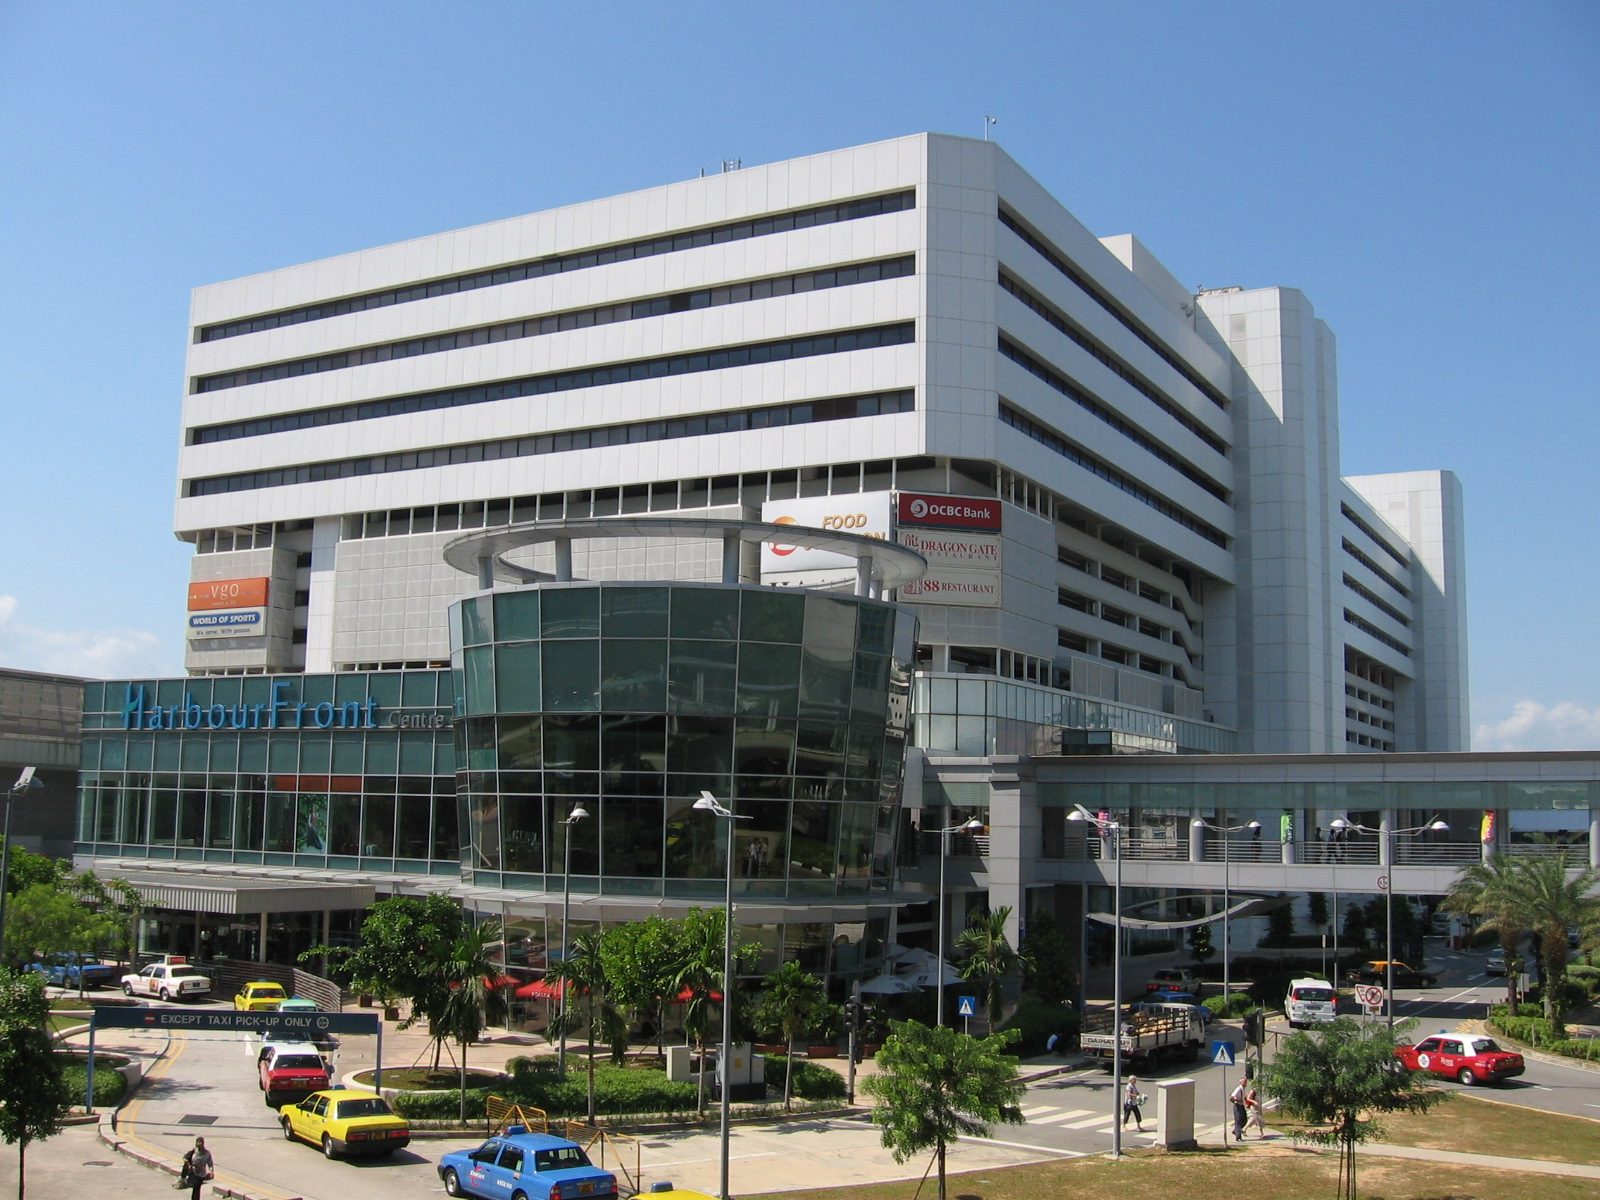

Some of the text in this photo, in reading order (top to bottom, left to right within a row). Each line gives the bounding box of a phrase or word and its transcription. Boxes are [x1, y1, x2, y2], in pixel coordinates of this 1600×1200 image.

[929, 504, 991, 519] OCBC Bank
[822, 513, 867, 529] FOOD
[921, 540, 998, 555] DRAGON GATE
[920, 551, 997, 561] RESTAURANT
[923, 580, 995, 593] 88 RESTAURANT
[192, 616, 217, 625] WORLD
[229, 614, 256, 623] SPORTS
[121, 682, 445, 730] HarbourFront Centre
[161, 1014, 312, 1028] EXCEPT TAXI PICK-UP ONLY
